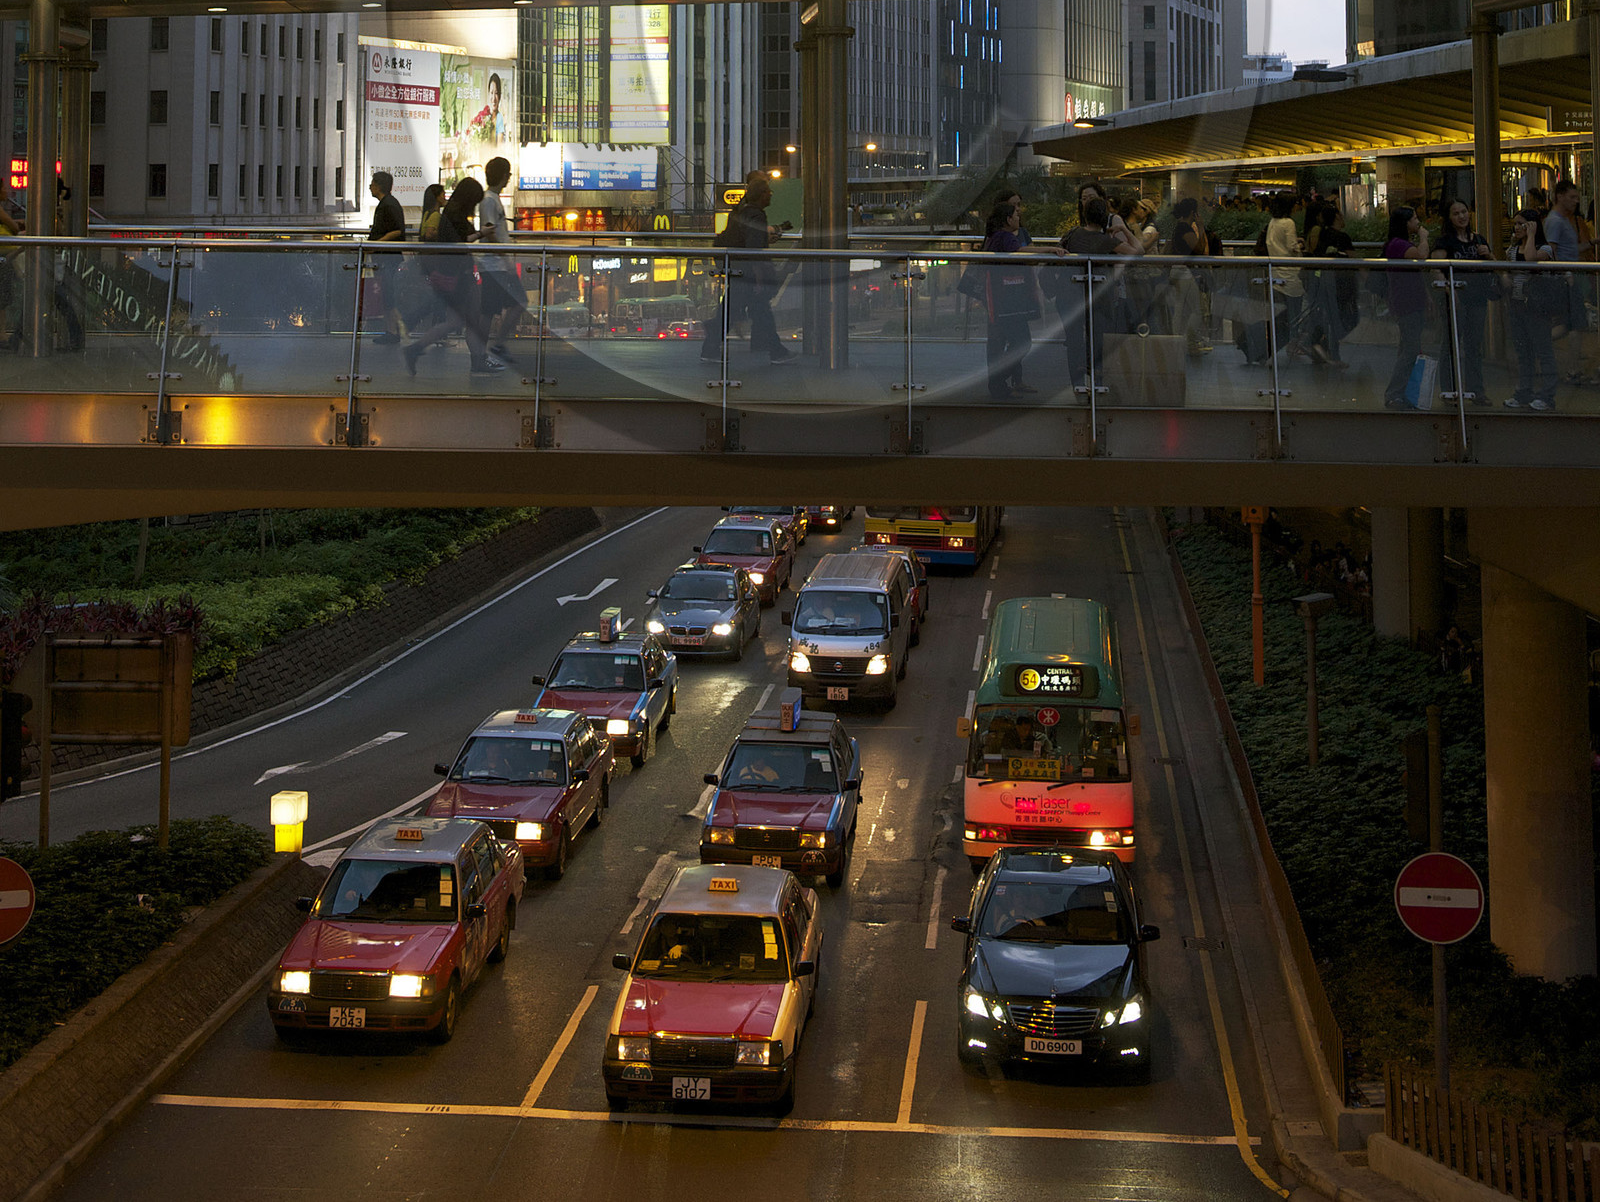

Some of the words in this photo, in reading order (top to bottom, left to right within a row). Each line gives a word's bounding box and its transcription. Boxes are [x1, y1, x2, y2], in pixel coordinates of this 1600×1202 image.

[384, 56, 412, 71] 永隆銀行
[394, 166, 408, 177] 2952
[409, 167, 422, 177] 6666
[392, 184, 425, 194] ungbank.com
[864, 642, 880, 653] 484
[1022, 673, 1037, 686] 54
[1041, 674, 1081, 685] 中環碼頭
[1041, 794, 1071, 809] laser
[398, 830, 419, 838] TAXI
[712, 880, 734, 889] TAXI
[341, 1007, 355, 1017] KE
[333, 1017, 363, 1027] 7043
[1031, 1040, 1045, 1051] DD
[1047, 1042, 1075, 1052] 6900
[682, 1078, 700, 1088] JY
[675, 1088, 707, 1098] 8107
